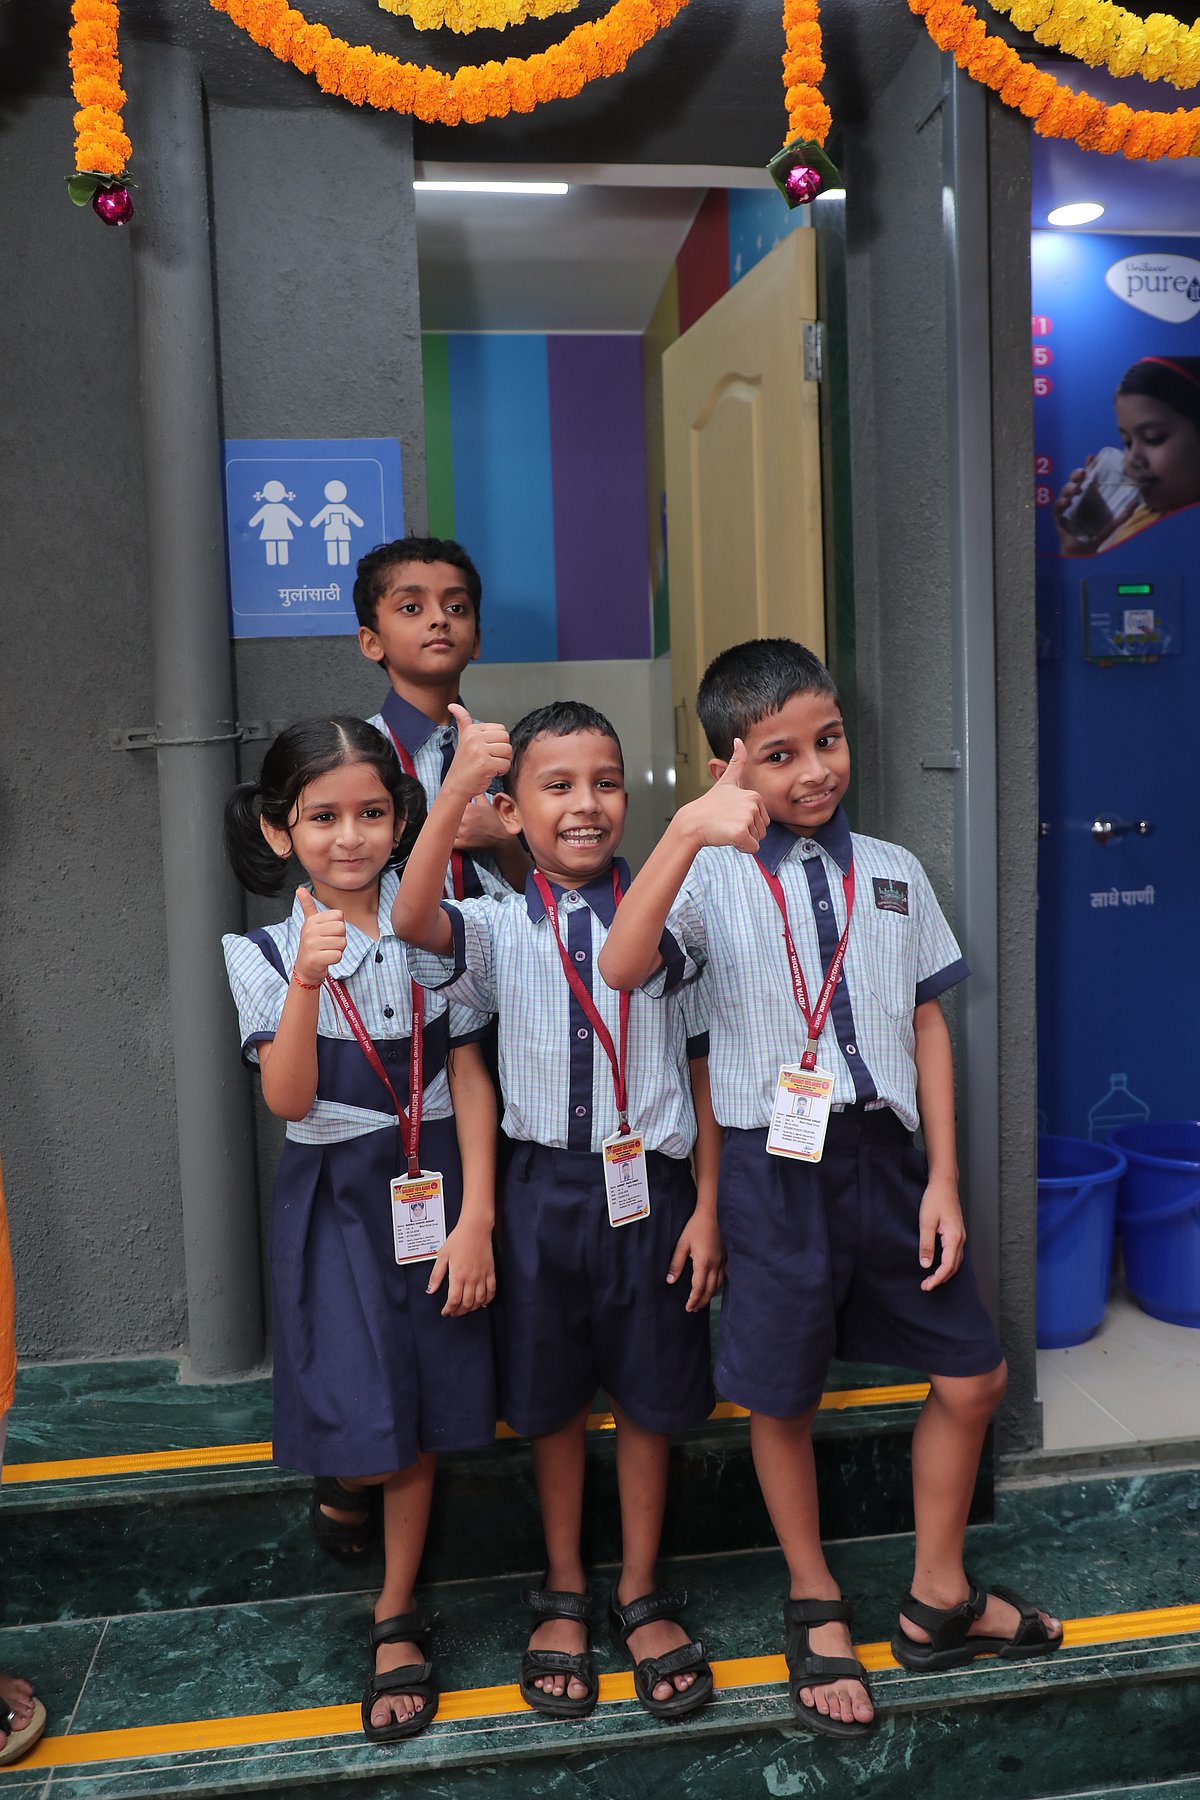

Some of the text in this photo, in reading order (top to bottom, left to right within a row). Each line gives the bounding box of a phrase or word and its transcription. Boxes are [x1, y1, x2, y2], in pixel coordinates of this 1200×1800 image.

[1034, 347, 1048, 366] 5
[1034, 378, 1048, 396] 5
[1037, 457, 1049, 474] 2
[1037, 487, 1049, 504] 8
[278, 582, 341, 607] मुलांसाठी
[1121, 885, 1154, 905] पाणी
